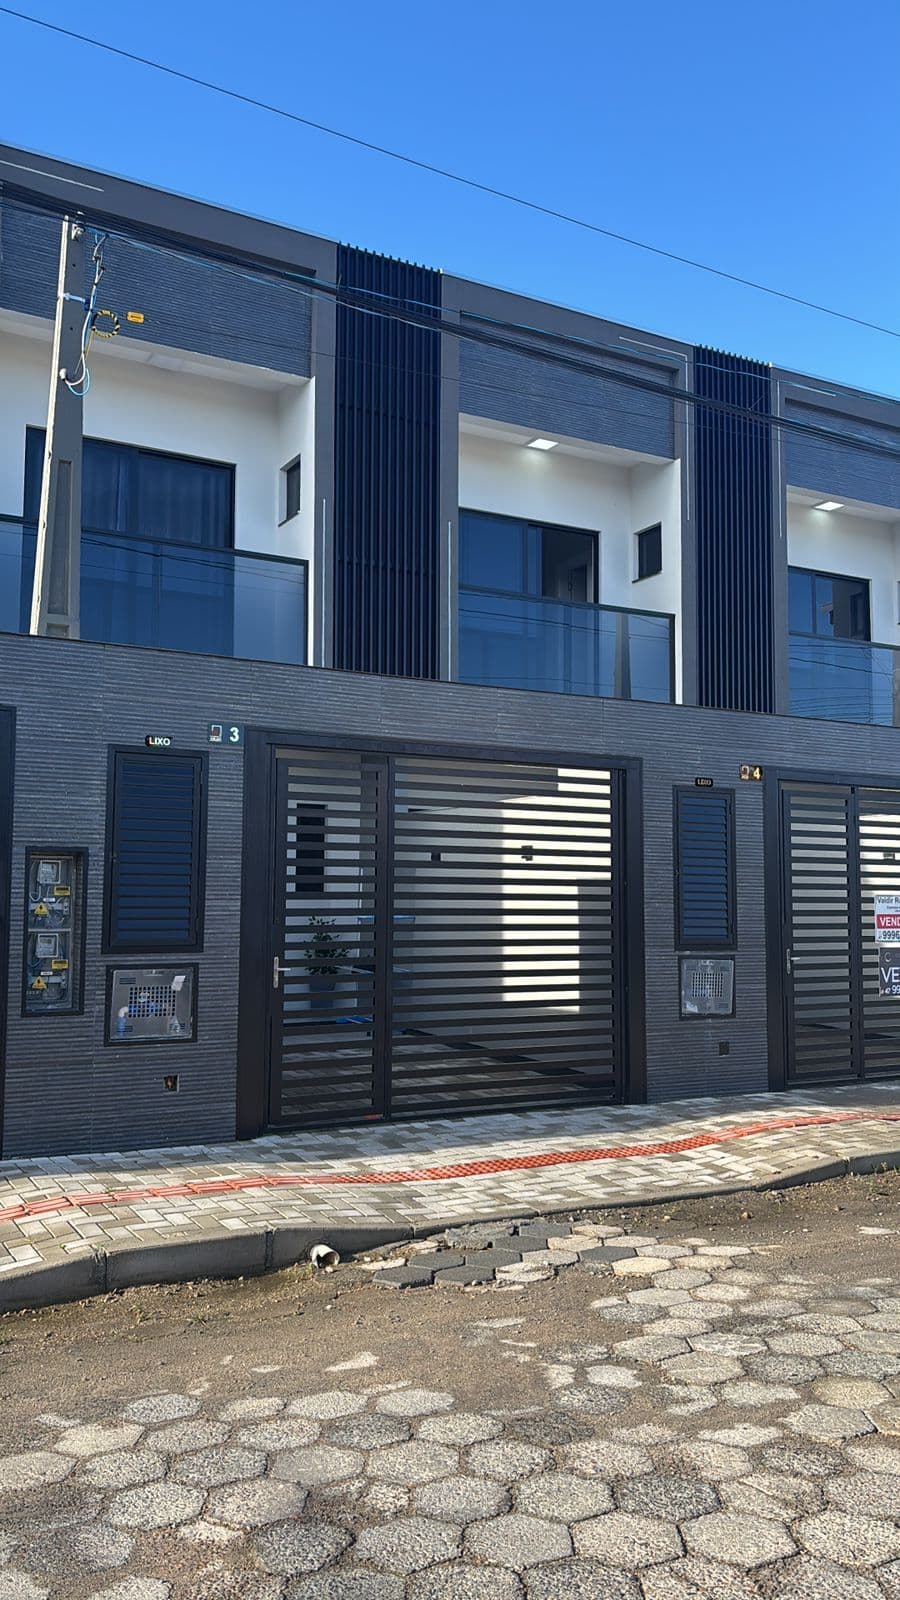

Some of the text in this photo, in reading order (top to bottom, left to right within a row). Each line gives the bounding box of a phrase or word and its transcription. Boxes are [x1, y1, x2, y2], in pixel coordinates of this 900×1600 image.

[149, 736, 171, 746] LIXO
[229, 727, 240, 742] 3
[753, 767, 761, 780] 4
